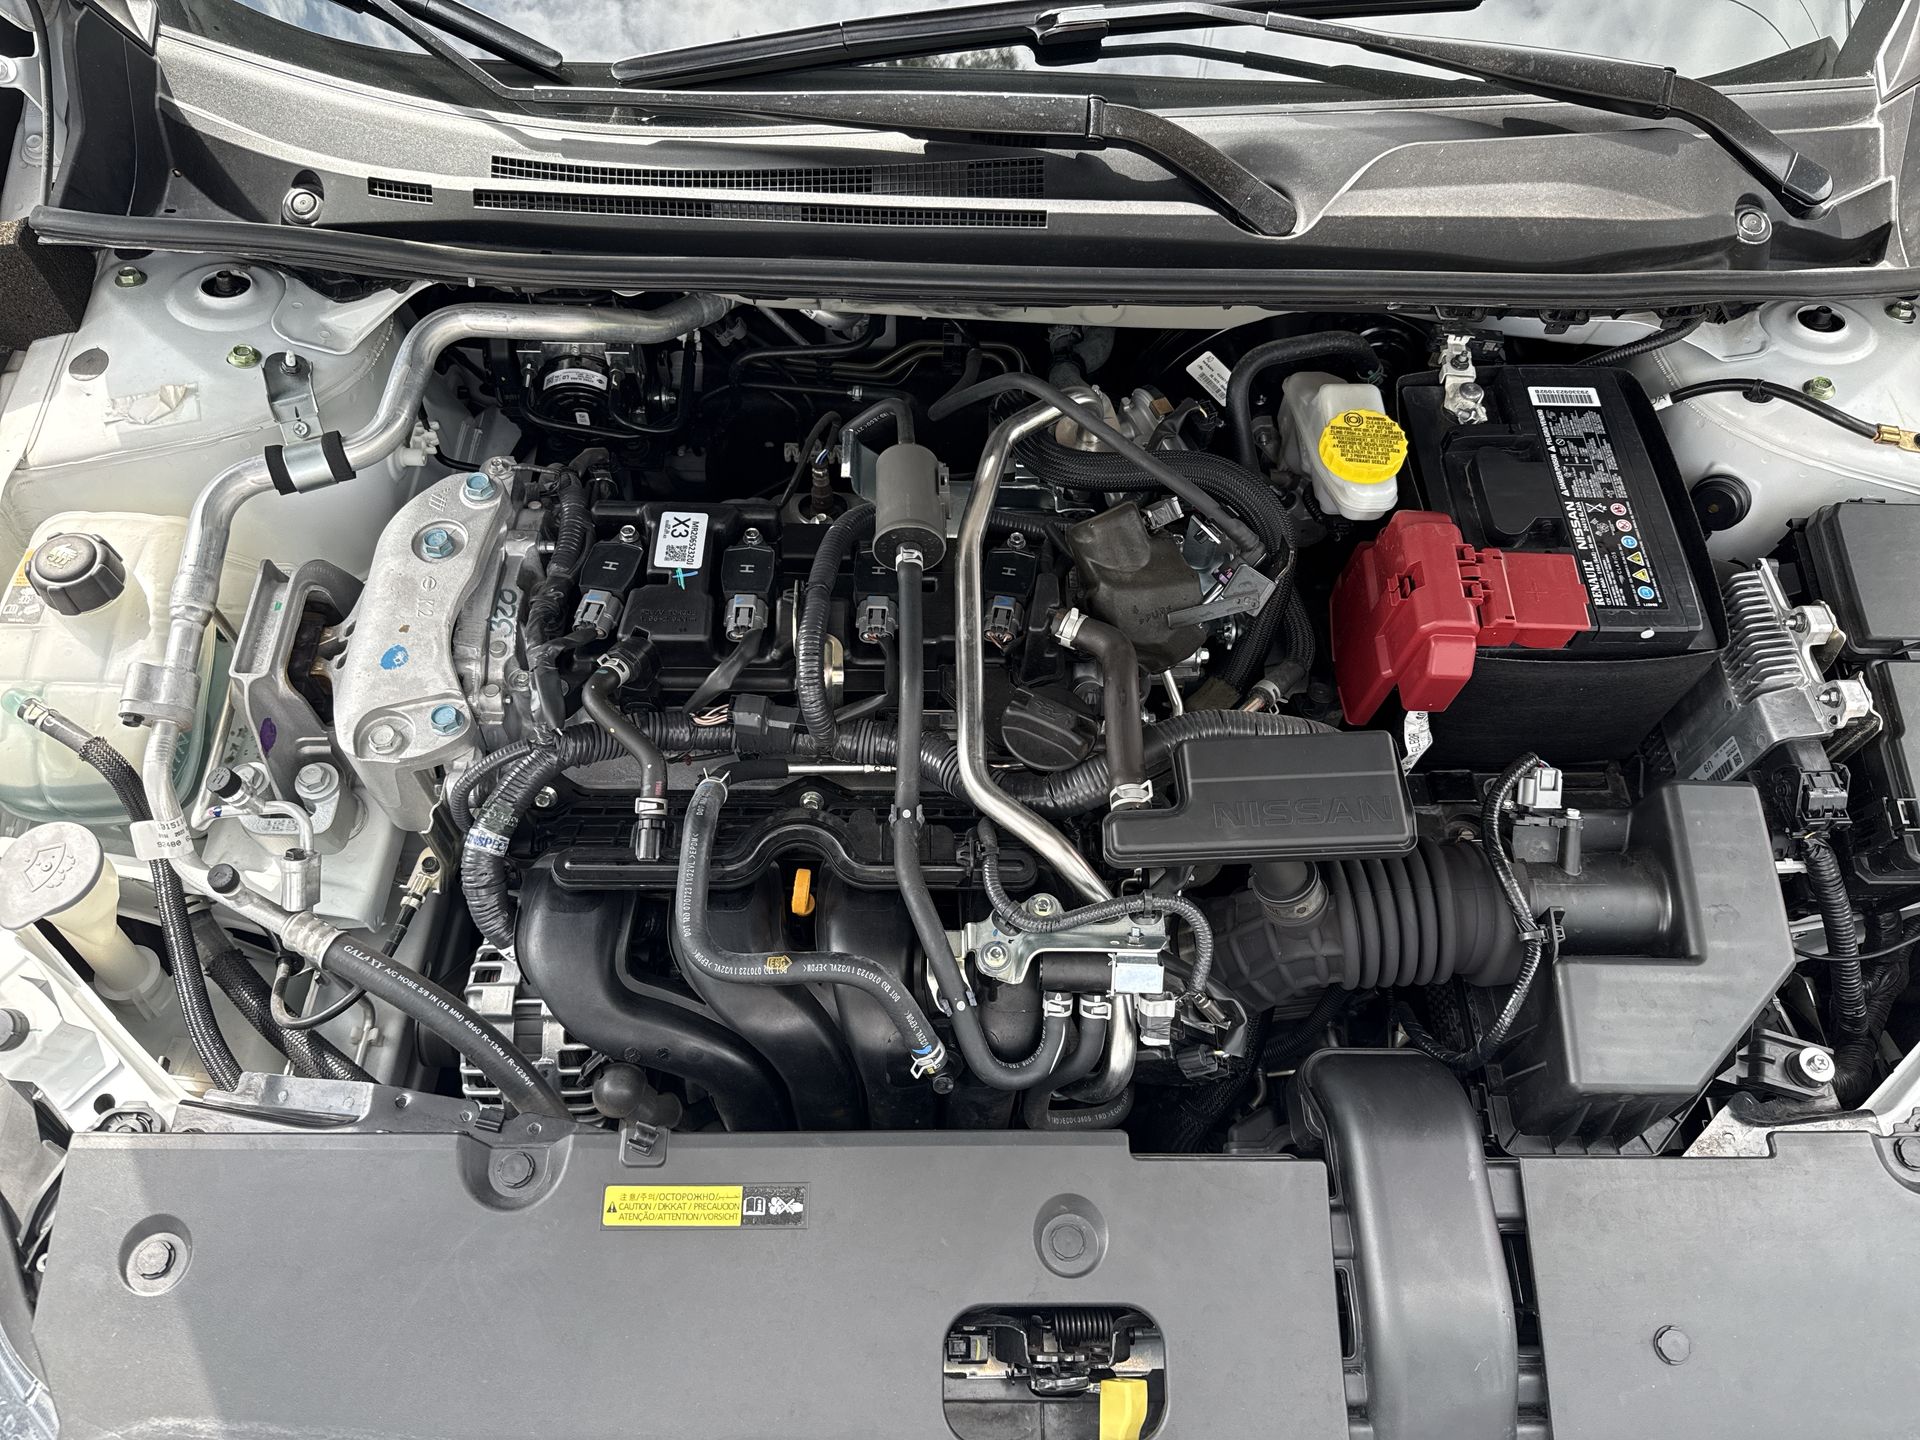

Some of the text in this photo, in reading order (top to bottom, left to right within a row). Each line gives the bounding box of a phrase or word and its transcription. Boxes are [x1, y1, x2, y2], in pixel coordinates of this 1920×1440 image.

[671, 516, 692, 539] X3
[1564, 501, 1606, 606] RENAULT NISSAN
[1212, 794, 1396, 829] NISSAN
[682, 886, 692, 910] 070723
[738, 966, 761, 975] 070723
[856, 967, 881, 984] 070723
[343, 944, 386, 971] GALAXY
[384, 966, 399, 979] A/C
[398, 973, 419, 991] HOSE
[417, 985, 430, 998] 5/8
[428, 992, 438, 1003] IN
[436, 997, 451, 1012] (16
[448, 1007, 465, 1024] MM)
[464, 1019, 483, 1036] 4860
[481, 1032, 506, 1057] R-134a
[507, 1057, 536, 1087] R-1234yf
[618, 1202, 652, 1211] CAUTION
[658, 1202, 687, 1211] DIKKAT
